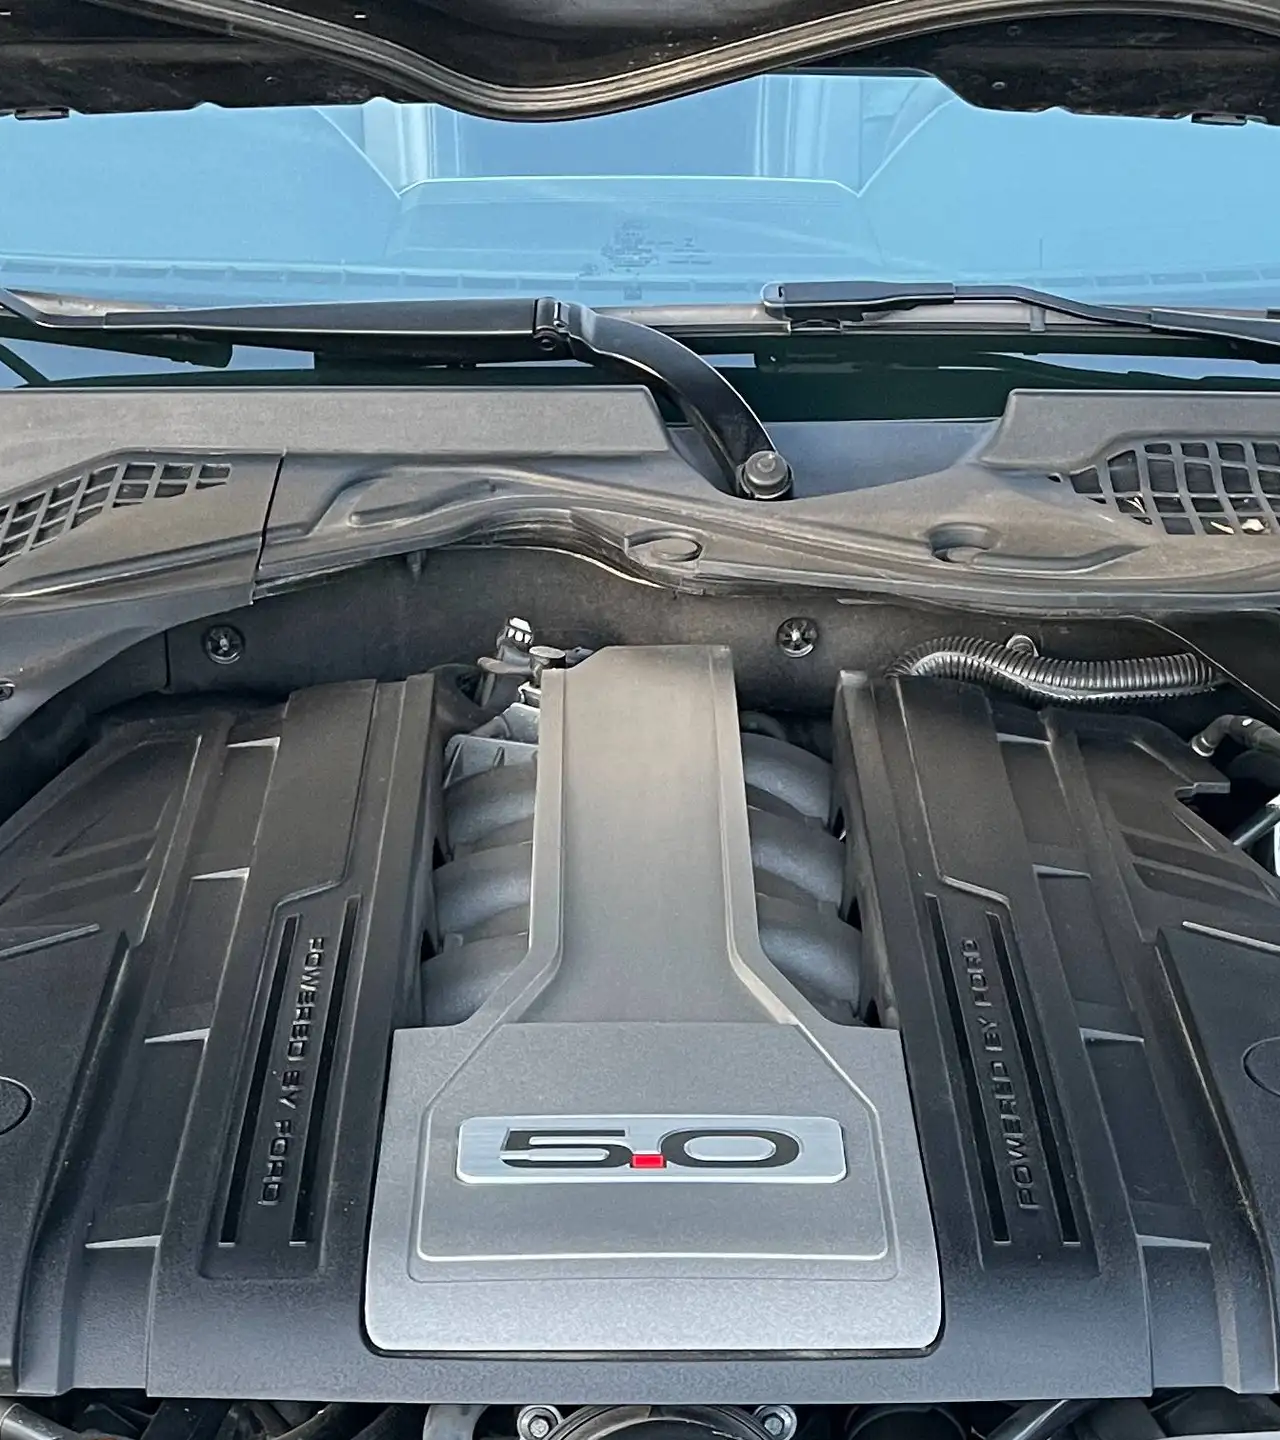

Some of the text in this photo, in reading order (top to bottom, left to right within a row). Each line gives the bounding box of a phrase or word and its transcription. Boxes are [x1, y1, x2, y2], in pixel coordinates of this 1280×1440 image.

[257, 937, 324, 1206] POWERED BY FORD
[500, 1129, 802, 1169] 5.0
[961, 939, 1042, 1209] POWERED BY FORD
